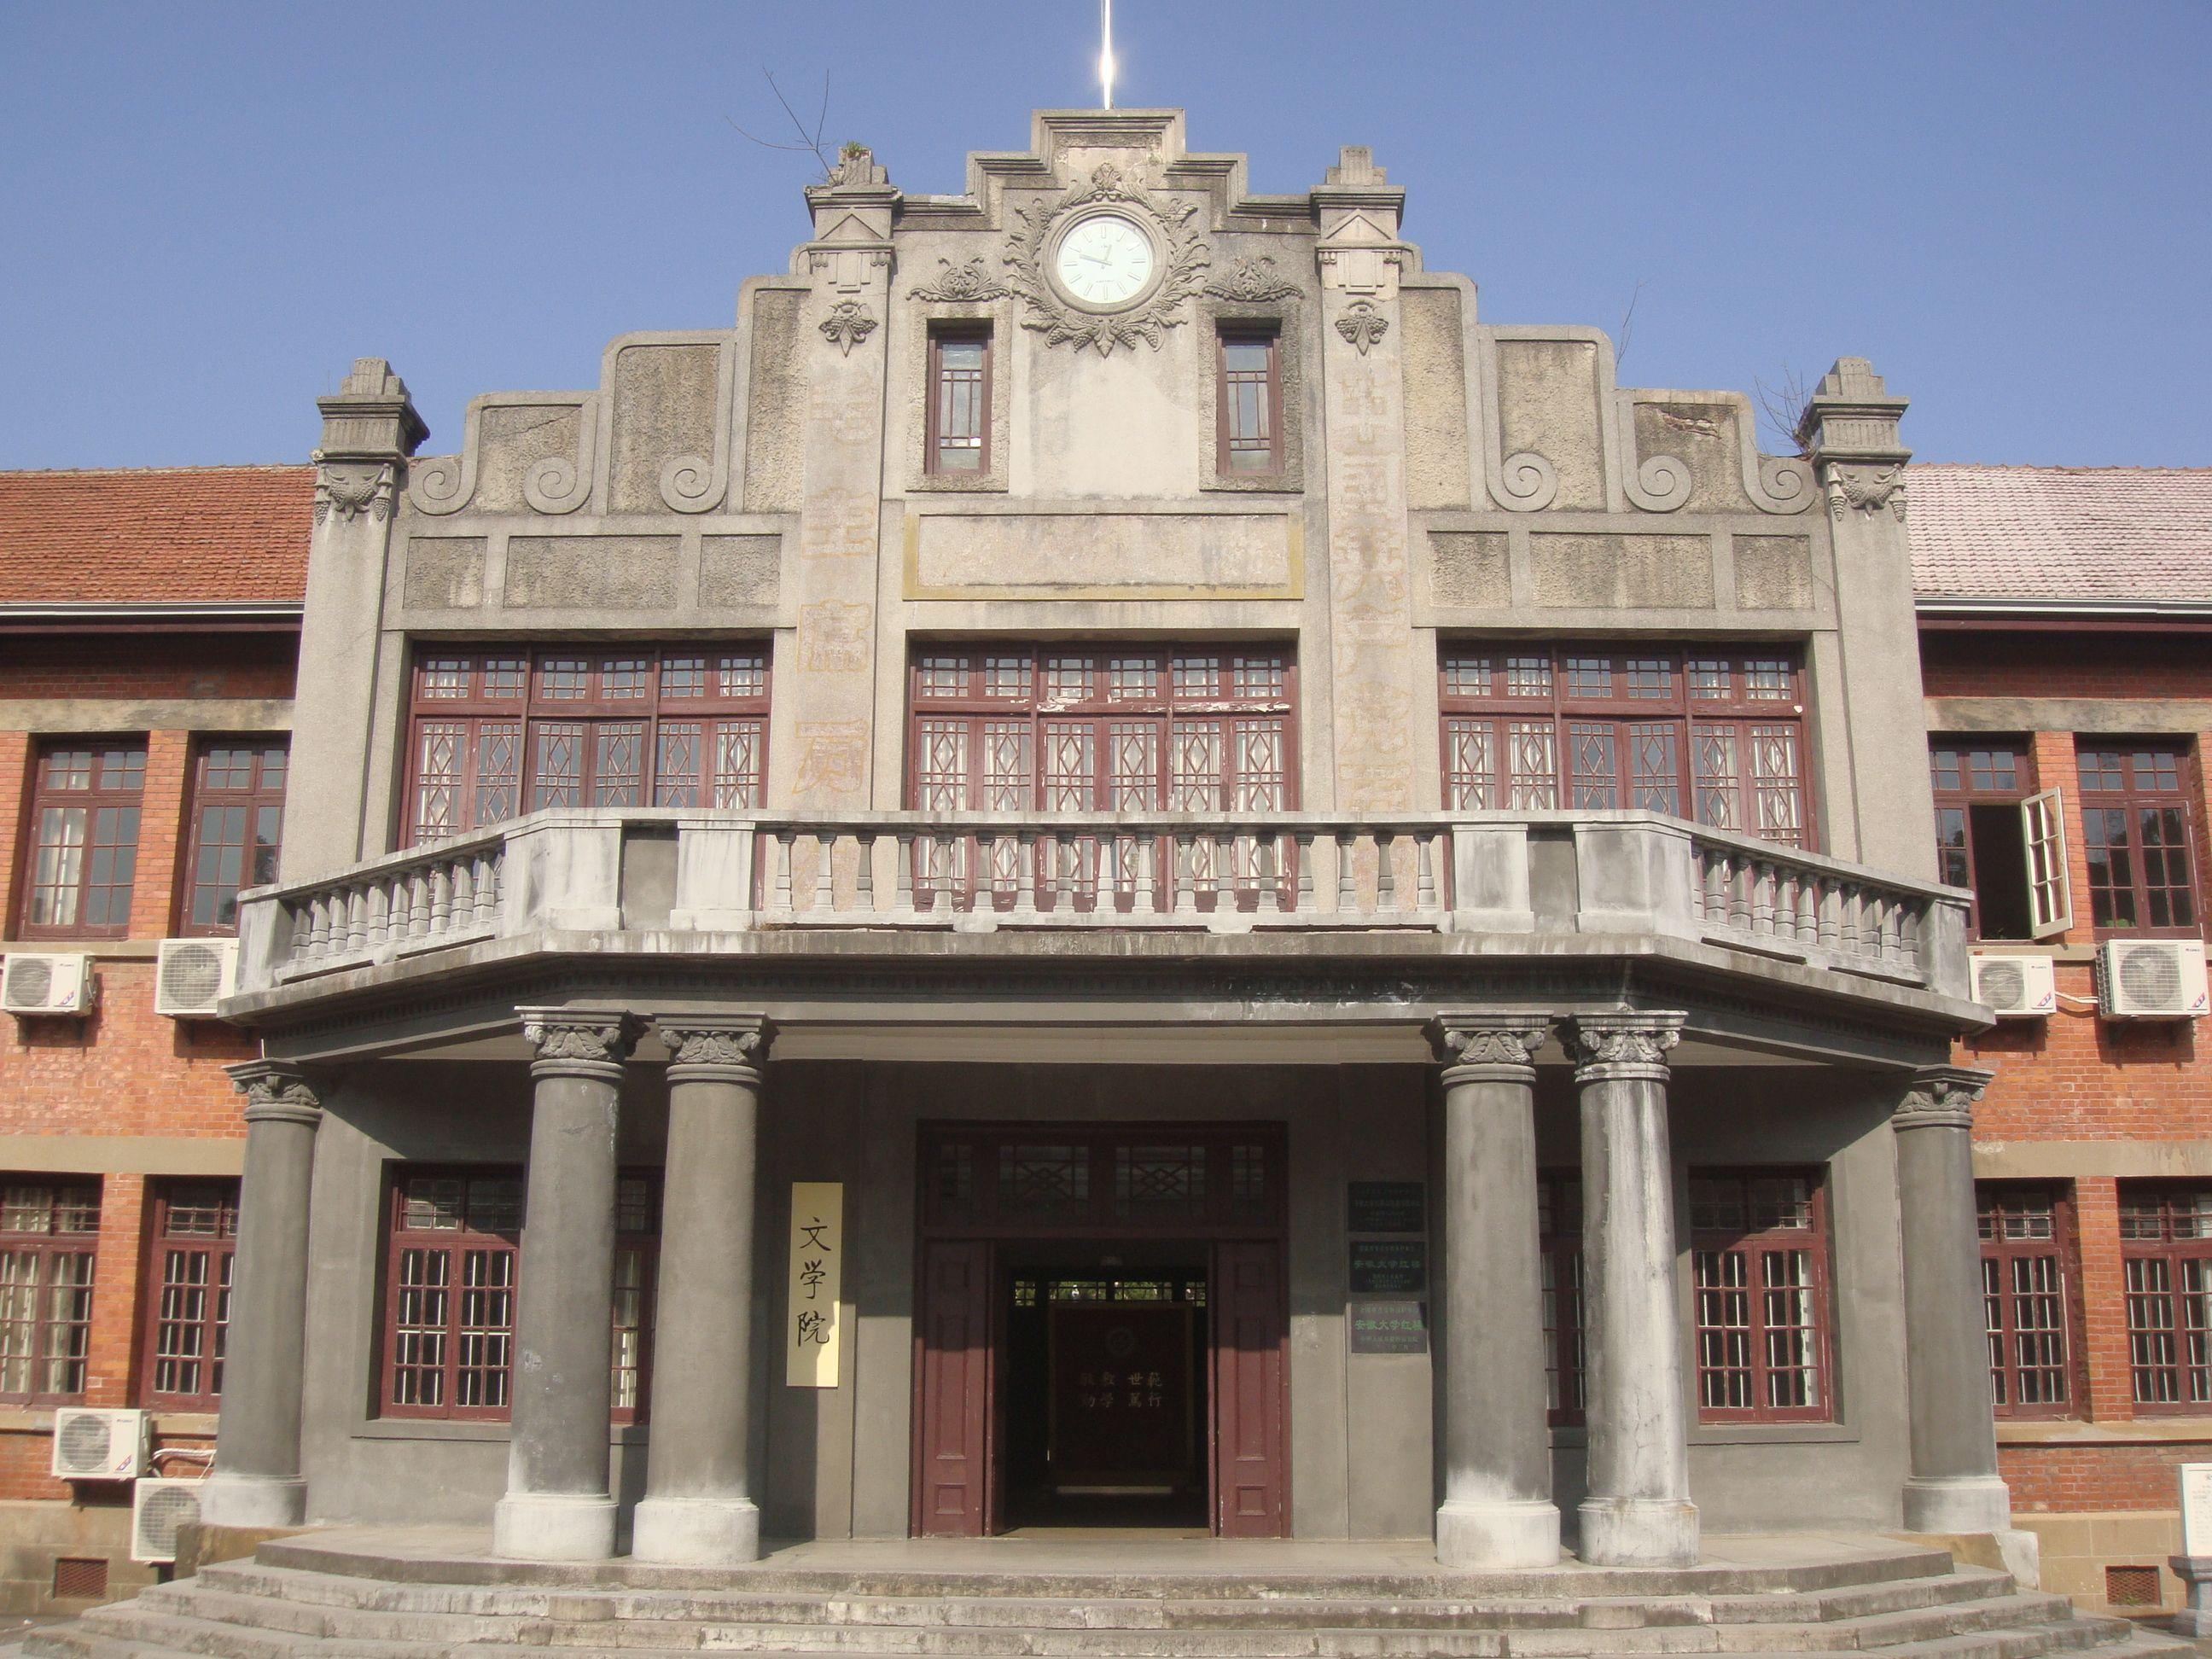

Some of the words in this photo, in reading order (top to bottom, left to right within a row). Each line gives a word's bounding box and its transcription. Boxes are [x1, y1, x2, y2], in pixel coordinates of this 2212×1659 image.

[797, 1217, 832, 1348] 文学院
[1354, 1319, 1423, 1330] 安徽大学红楼
